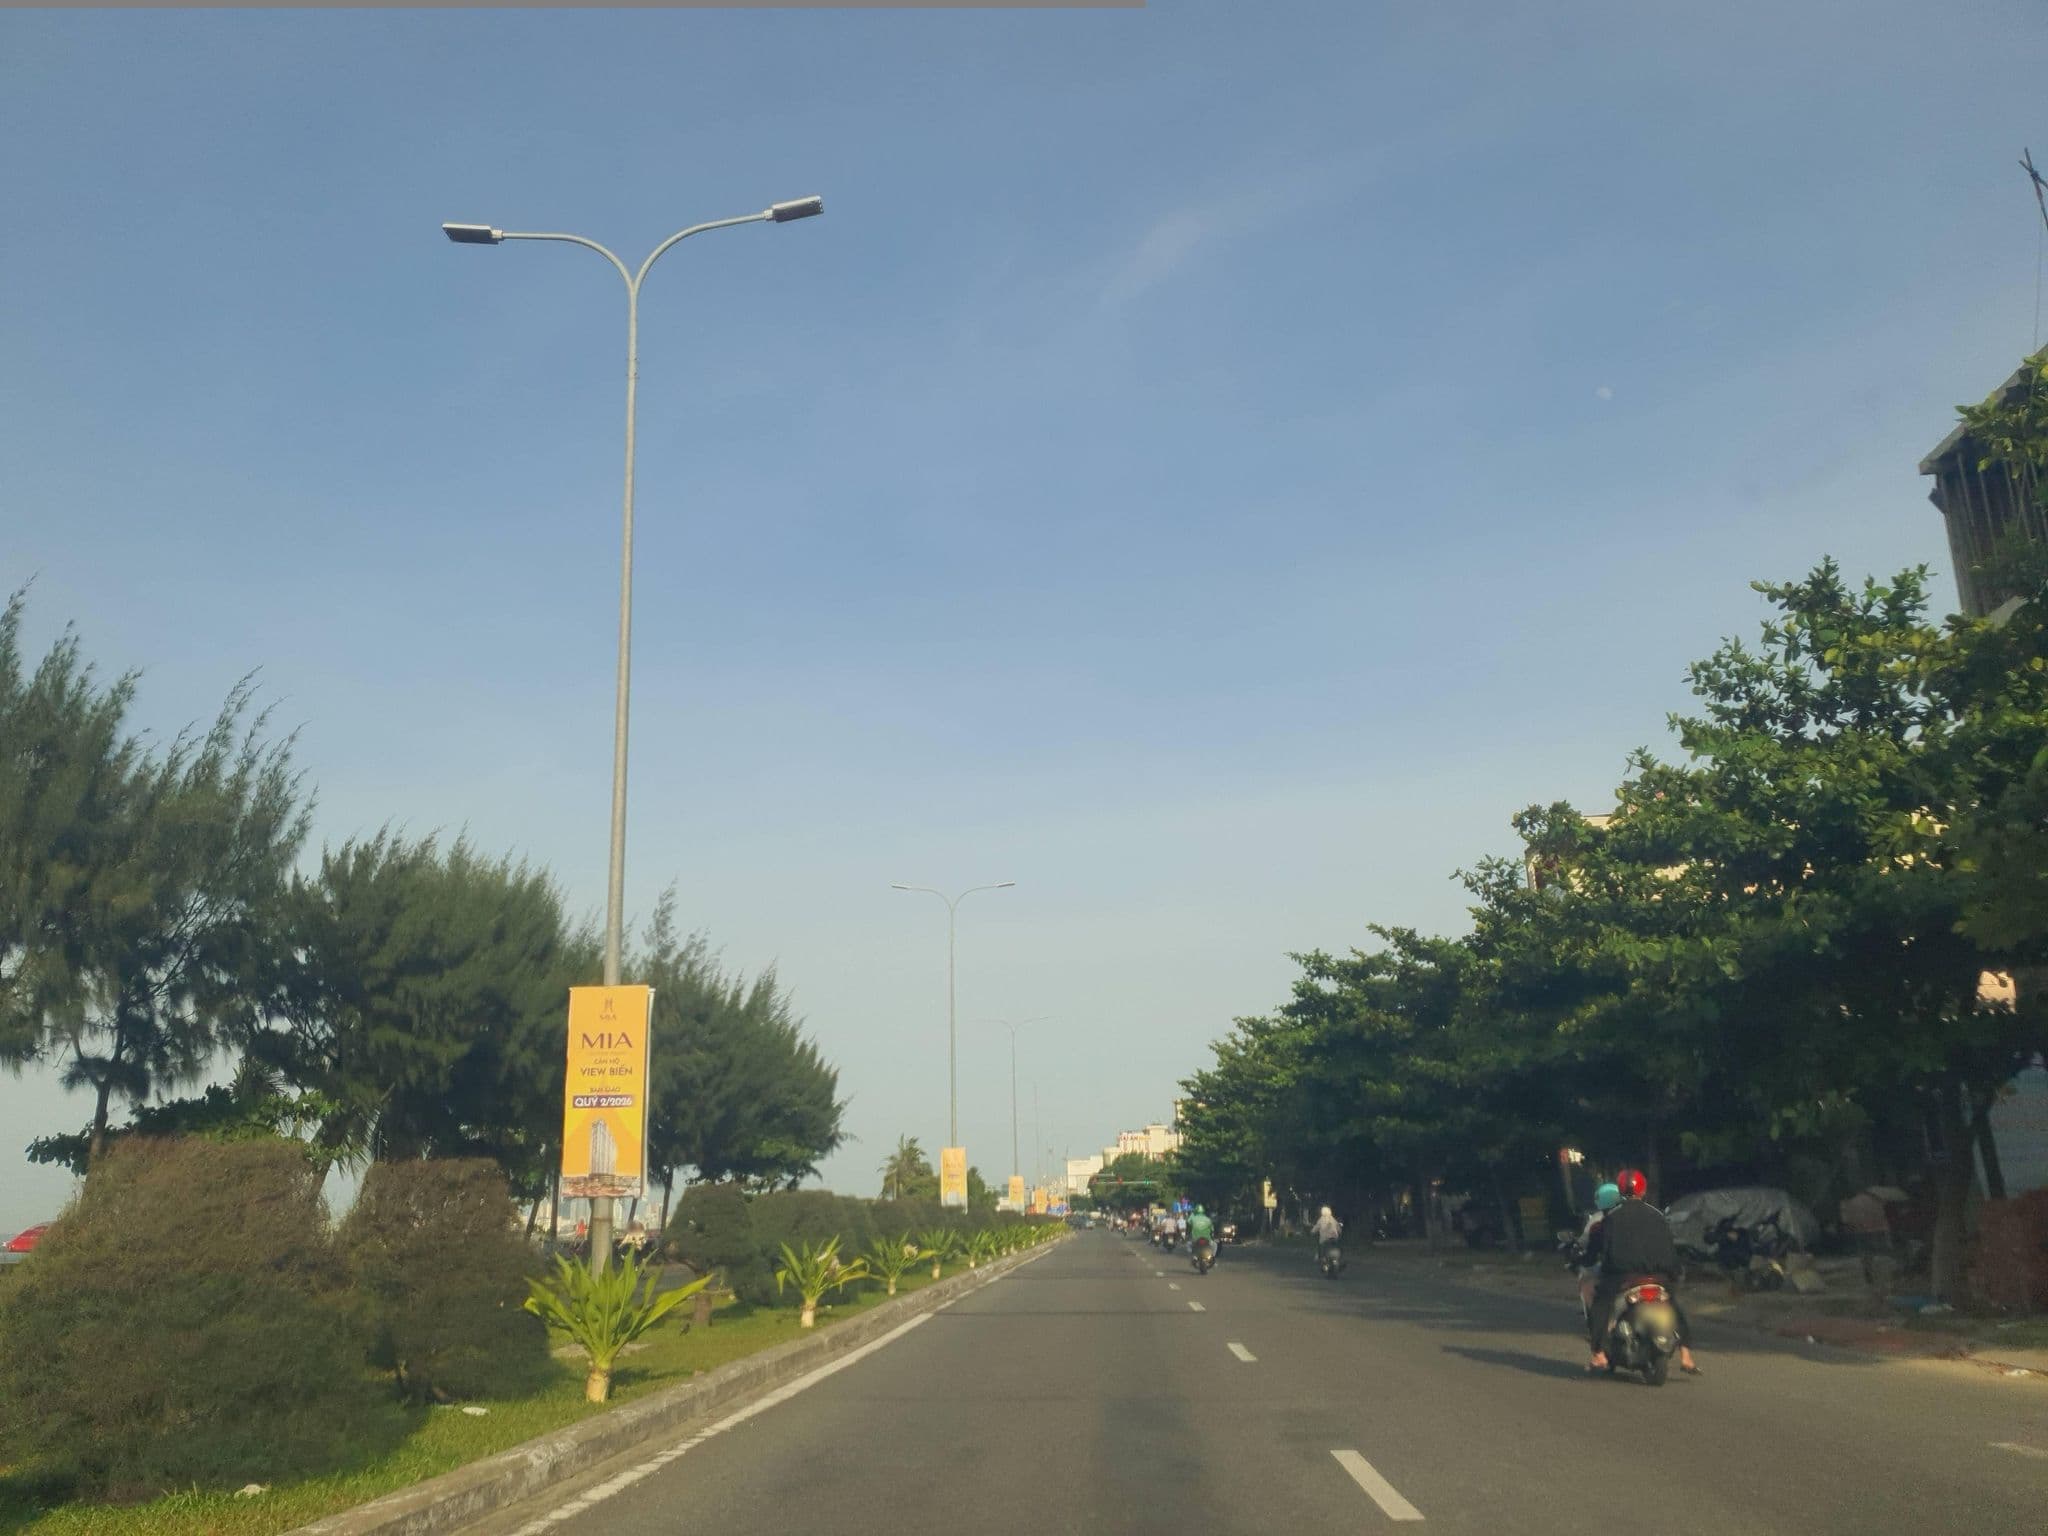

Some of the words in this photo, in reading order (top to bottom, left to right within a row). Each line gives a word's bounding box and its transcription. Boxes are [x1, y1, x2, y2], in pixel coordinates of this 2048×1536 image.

[582, 1032, 633, 1048] MIA
[581, 1067, 606, 1076] VIEW
[574, 1095, 598, 1106] QUÝ
